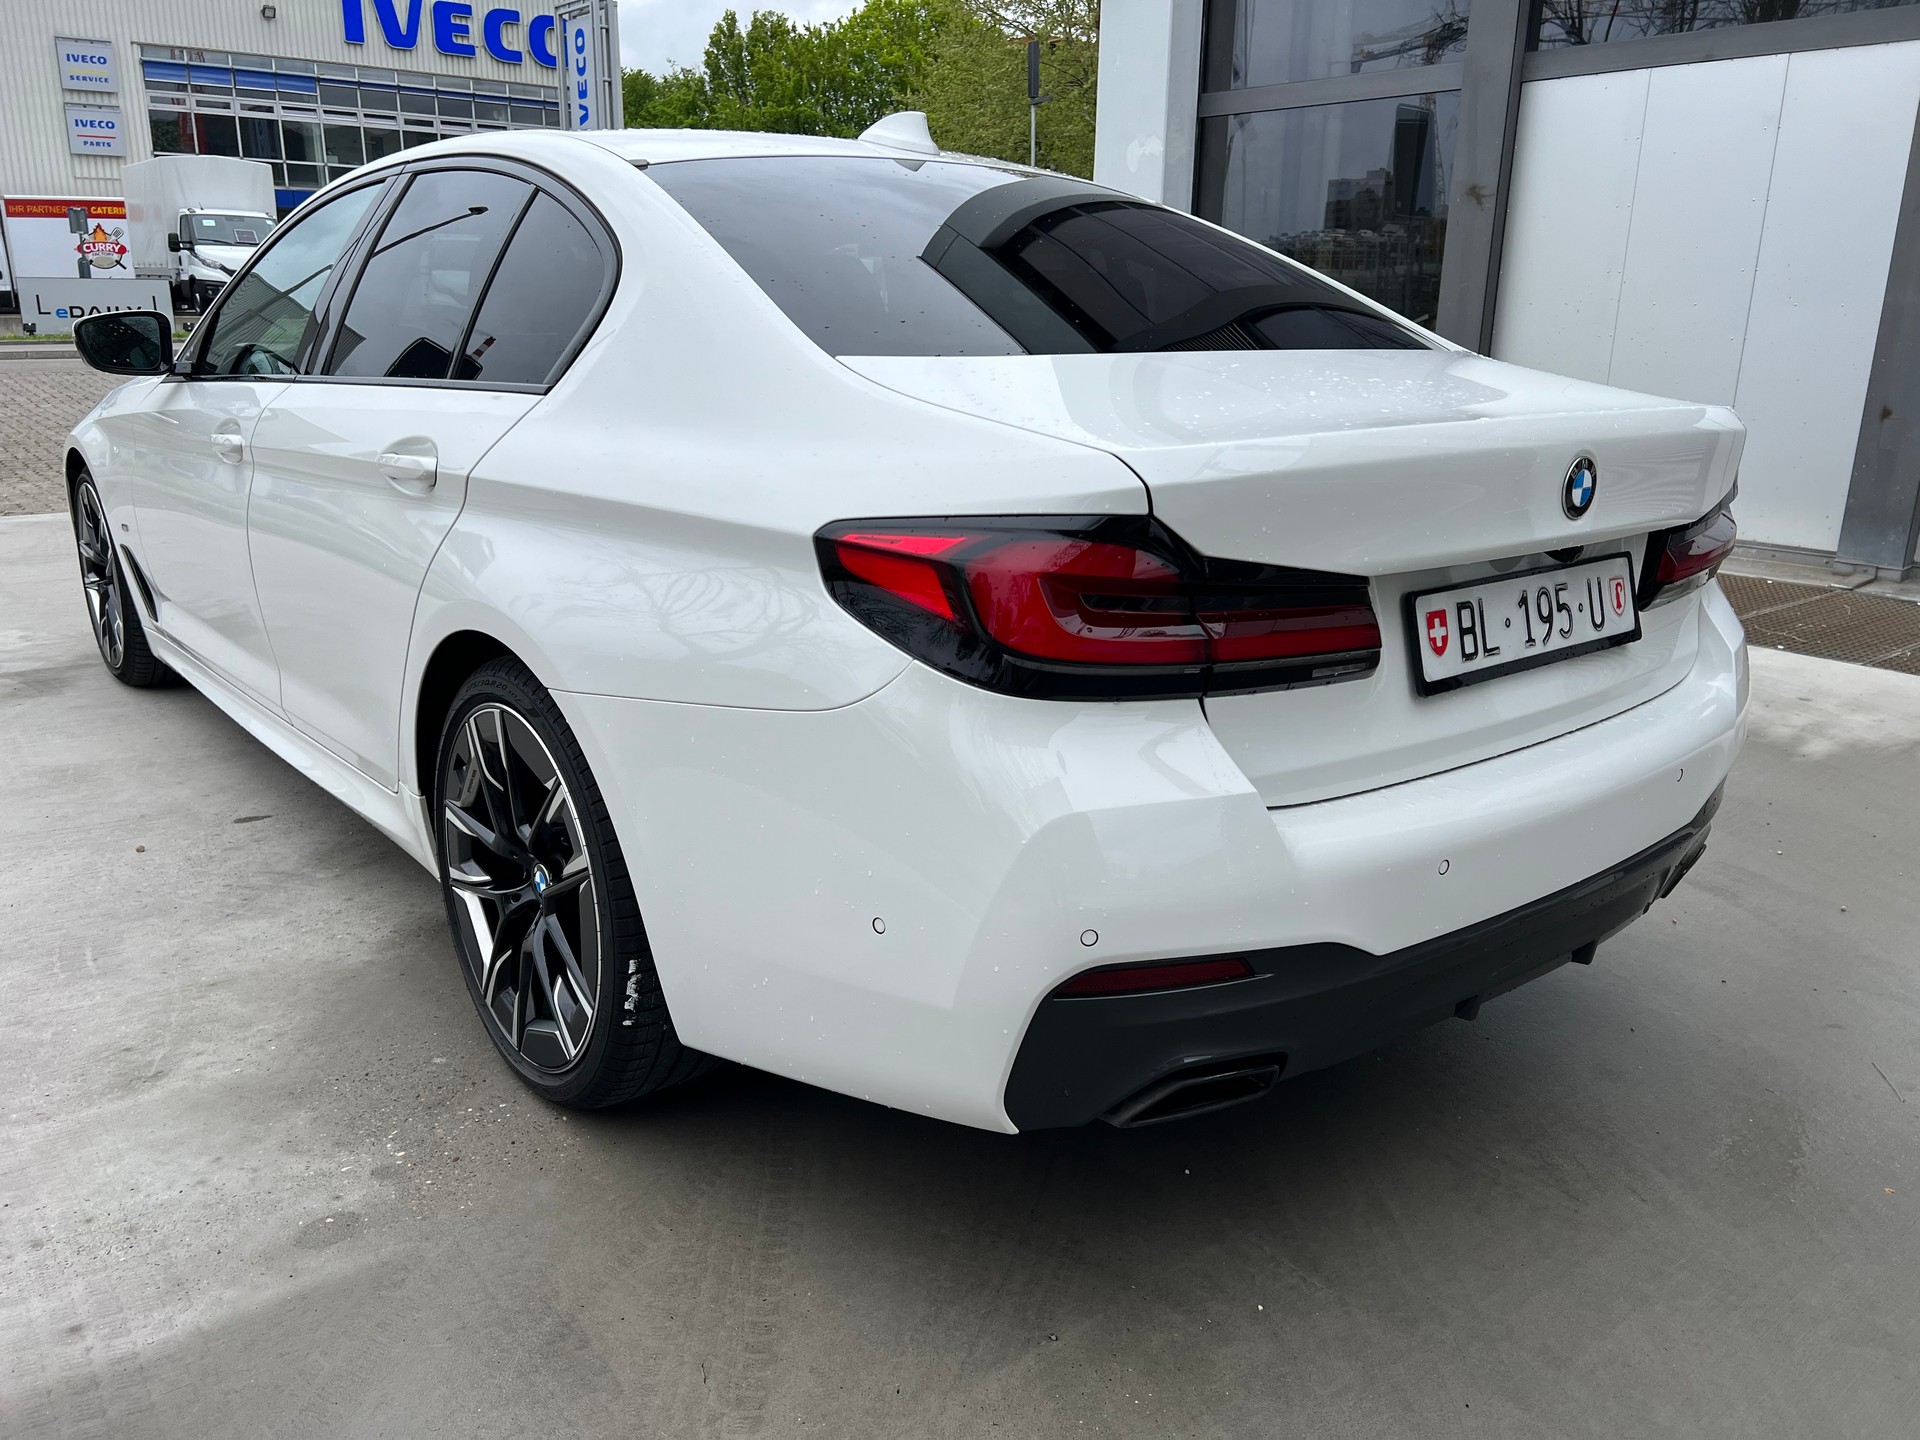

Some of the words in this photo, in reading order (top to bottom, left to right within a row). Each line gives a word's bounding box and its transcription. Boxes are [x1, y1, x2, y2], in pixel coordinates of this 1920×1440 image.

[341, 0, 568, 69] IVECO
[66, 53, 107, 65] IVECO
[69, 75, 110, 83] SERVICE
[575, 28, 590, 130] VECO
[74, 119, 116, 129] IVECO
[8, 205, 25, 213] IHR
[27, 205, 67, 214] PARTNER
[83, 242, 121, 253] CURRY
